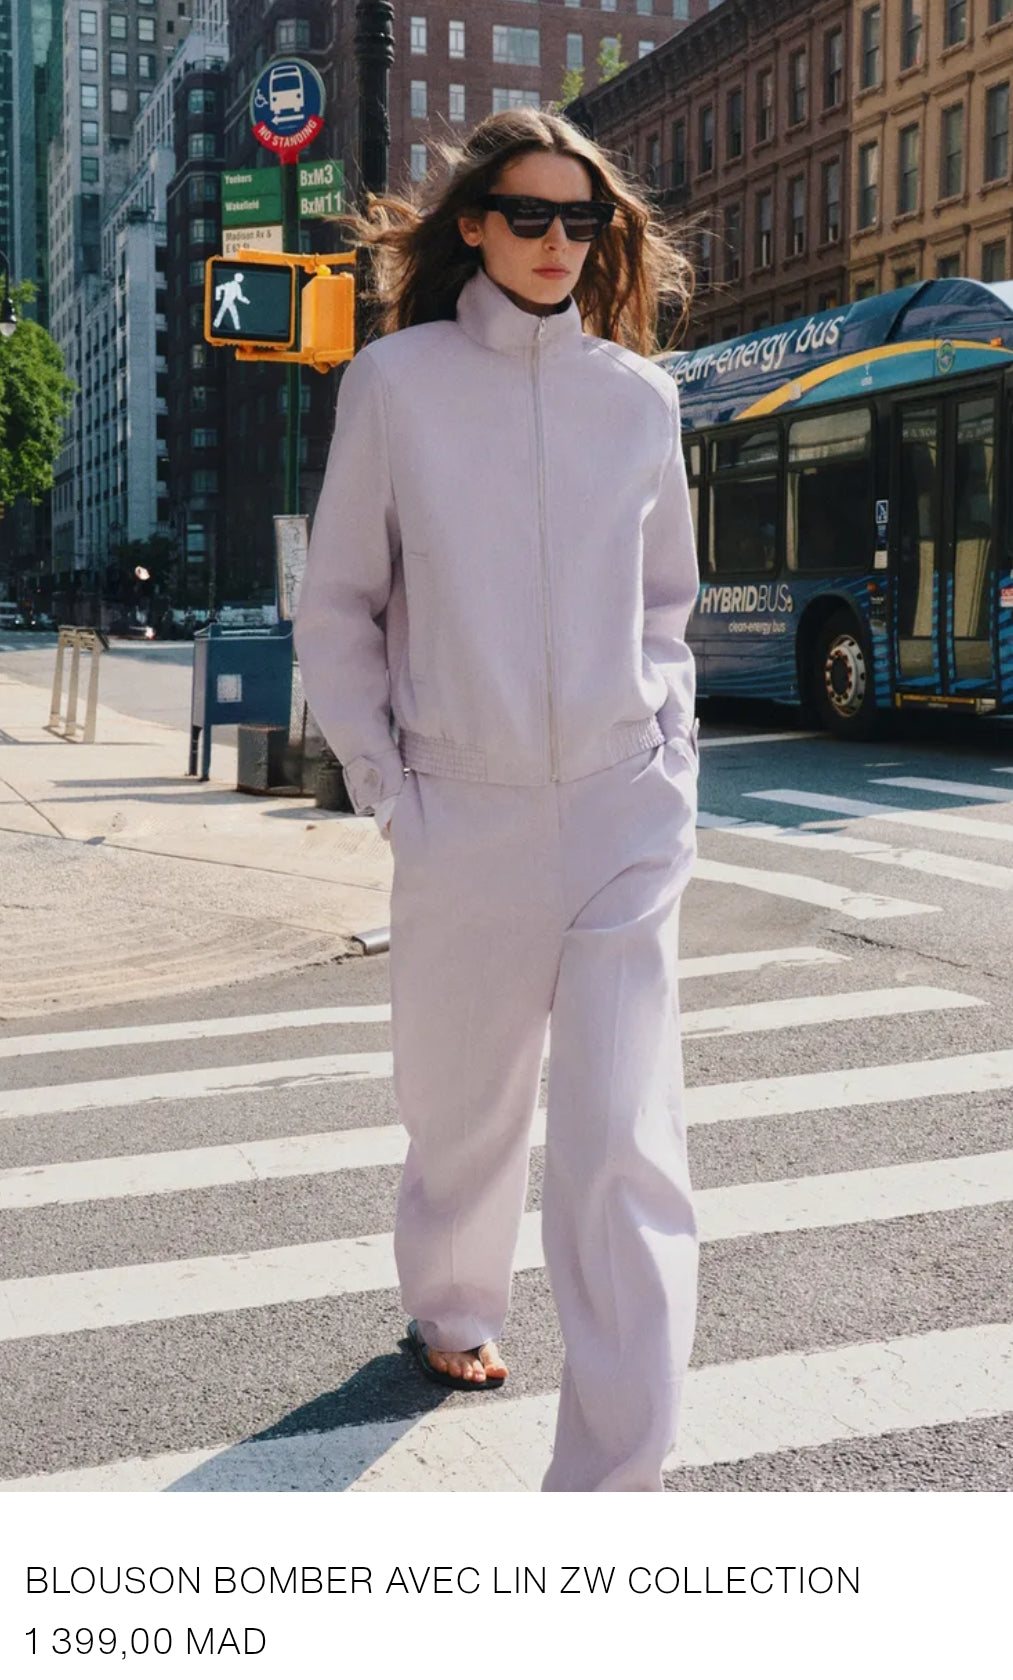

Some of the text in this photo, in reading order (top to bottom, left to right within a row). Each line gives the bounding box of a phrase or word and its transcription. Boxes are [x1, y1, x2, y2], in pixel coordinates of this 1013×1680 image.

[258, 119, 318, 148] NO STANDING
[300, 164, 333, 186] BxM3
[225, 199, 260, 212] Wakefield
[300, 191, 342, 215] BxM11
[795, 315, 845, 354] bus
[729, 619, 786, 635] clean-energy bus
